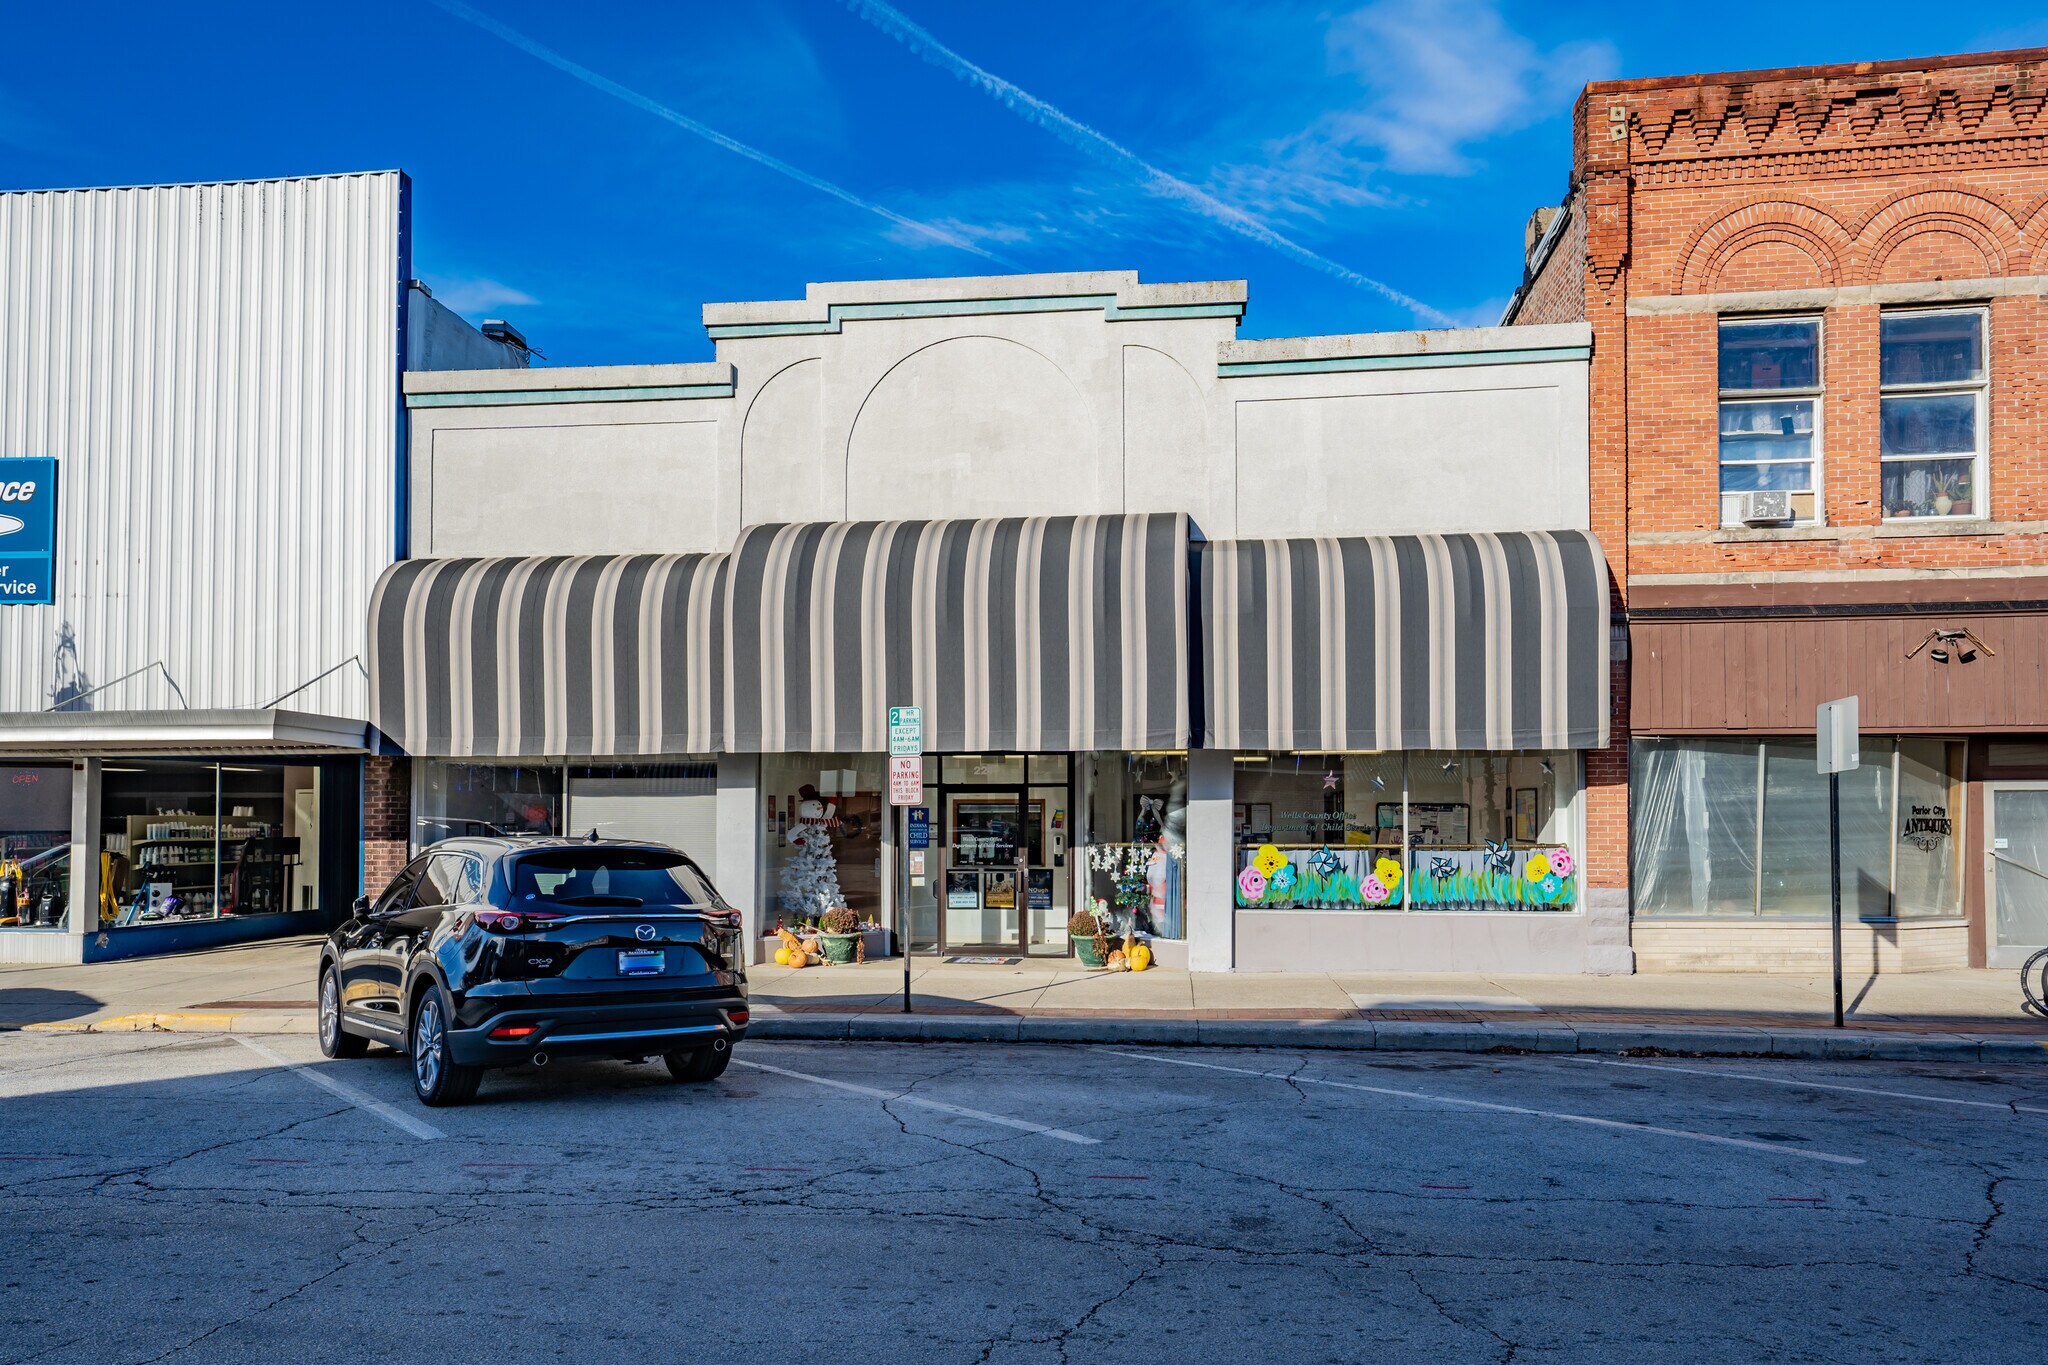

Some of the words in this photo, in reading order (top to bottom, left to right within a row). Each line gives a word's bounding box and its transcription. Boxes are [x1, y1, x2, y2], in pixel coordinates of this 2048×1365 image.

[891, 711, 899, 724] 2
[900, 760, 911, 769] NO
[12, 774, 39, 784] OPEN
[893, 771, 919, 779] PARKING
[1280, 811, 1302, 819] Wells
[1302, 811, 1331, 820] County
[1332, 811, 1357, 819] Office
[1912, 805, 1931, 815] Parlor
[1933, 805, 1945, 817] City
[1261, 823, 1310, 831] Department
[1320, 823, 1343, 831] Child
[1903, 818, 1952, 837] ANTIQUES
